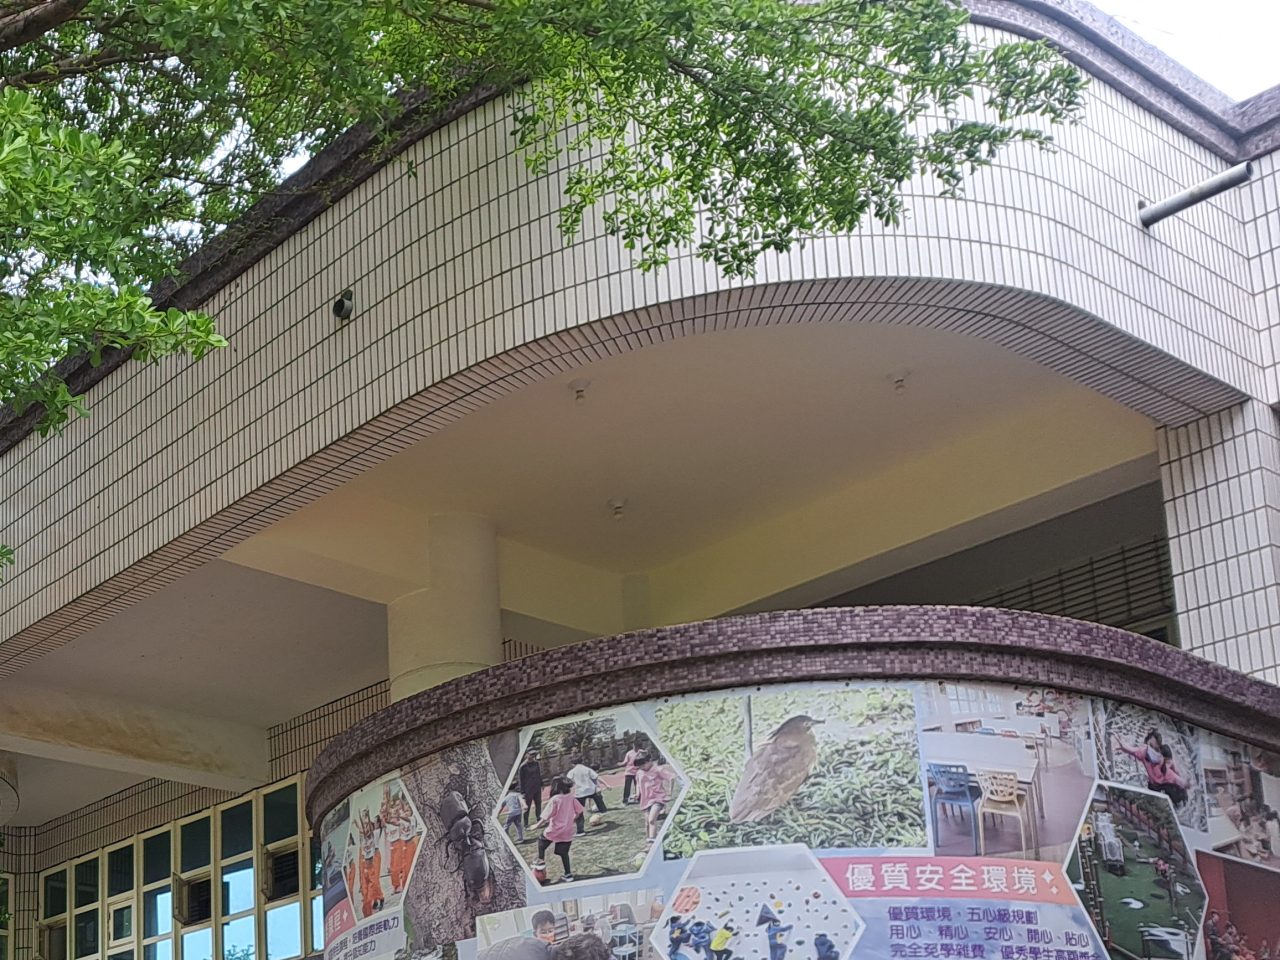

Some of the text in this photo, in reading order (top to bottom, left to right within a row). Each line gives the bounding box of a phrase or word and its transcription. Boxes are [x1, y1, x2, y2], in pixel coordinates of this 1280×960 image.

[845, 863, 1038, 895] 優質安全環境
